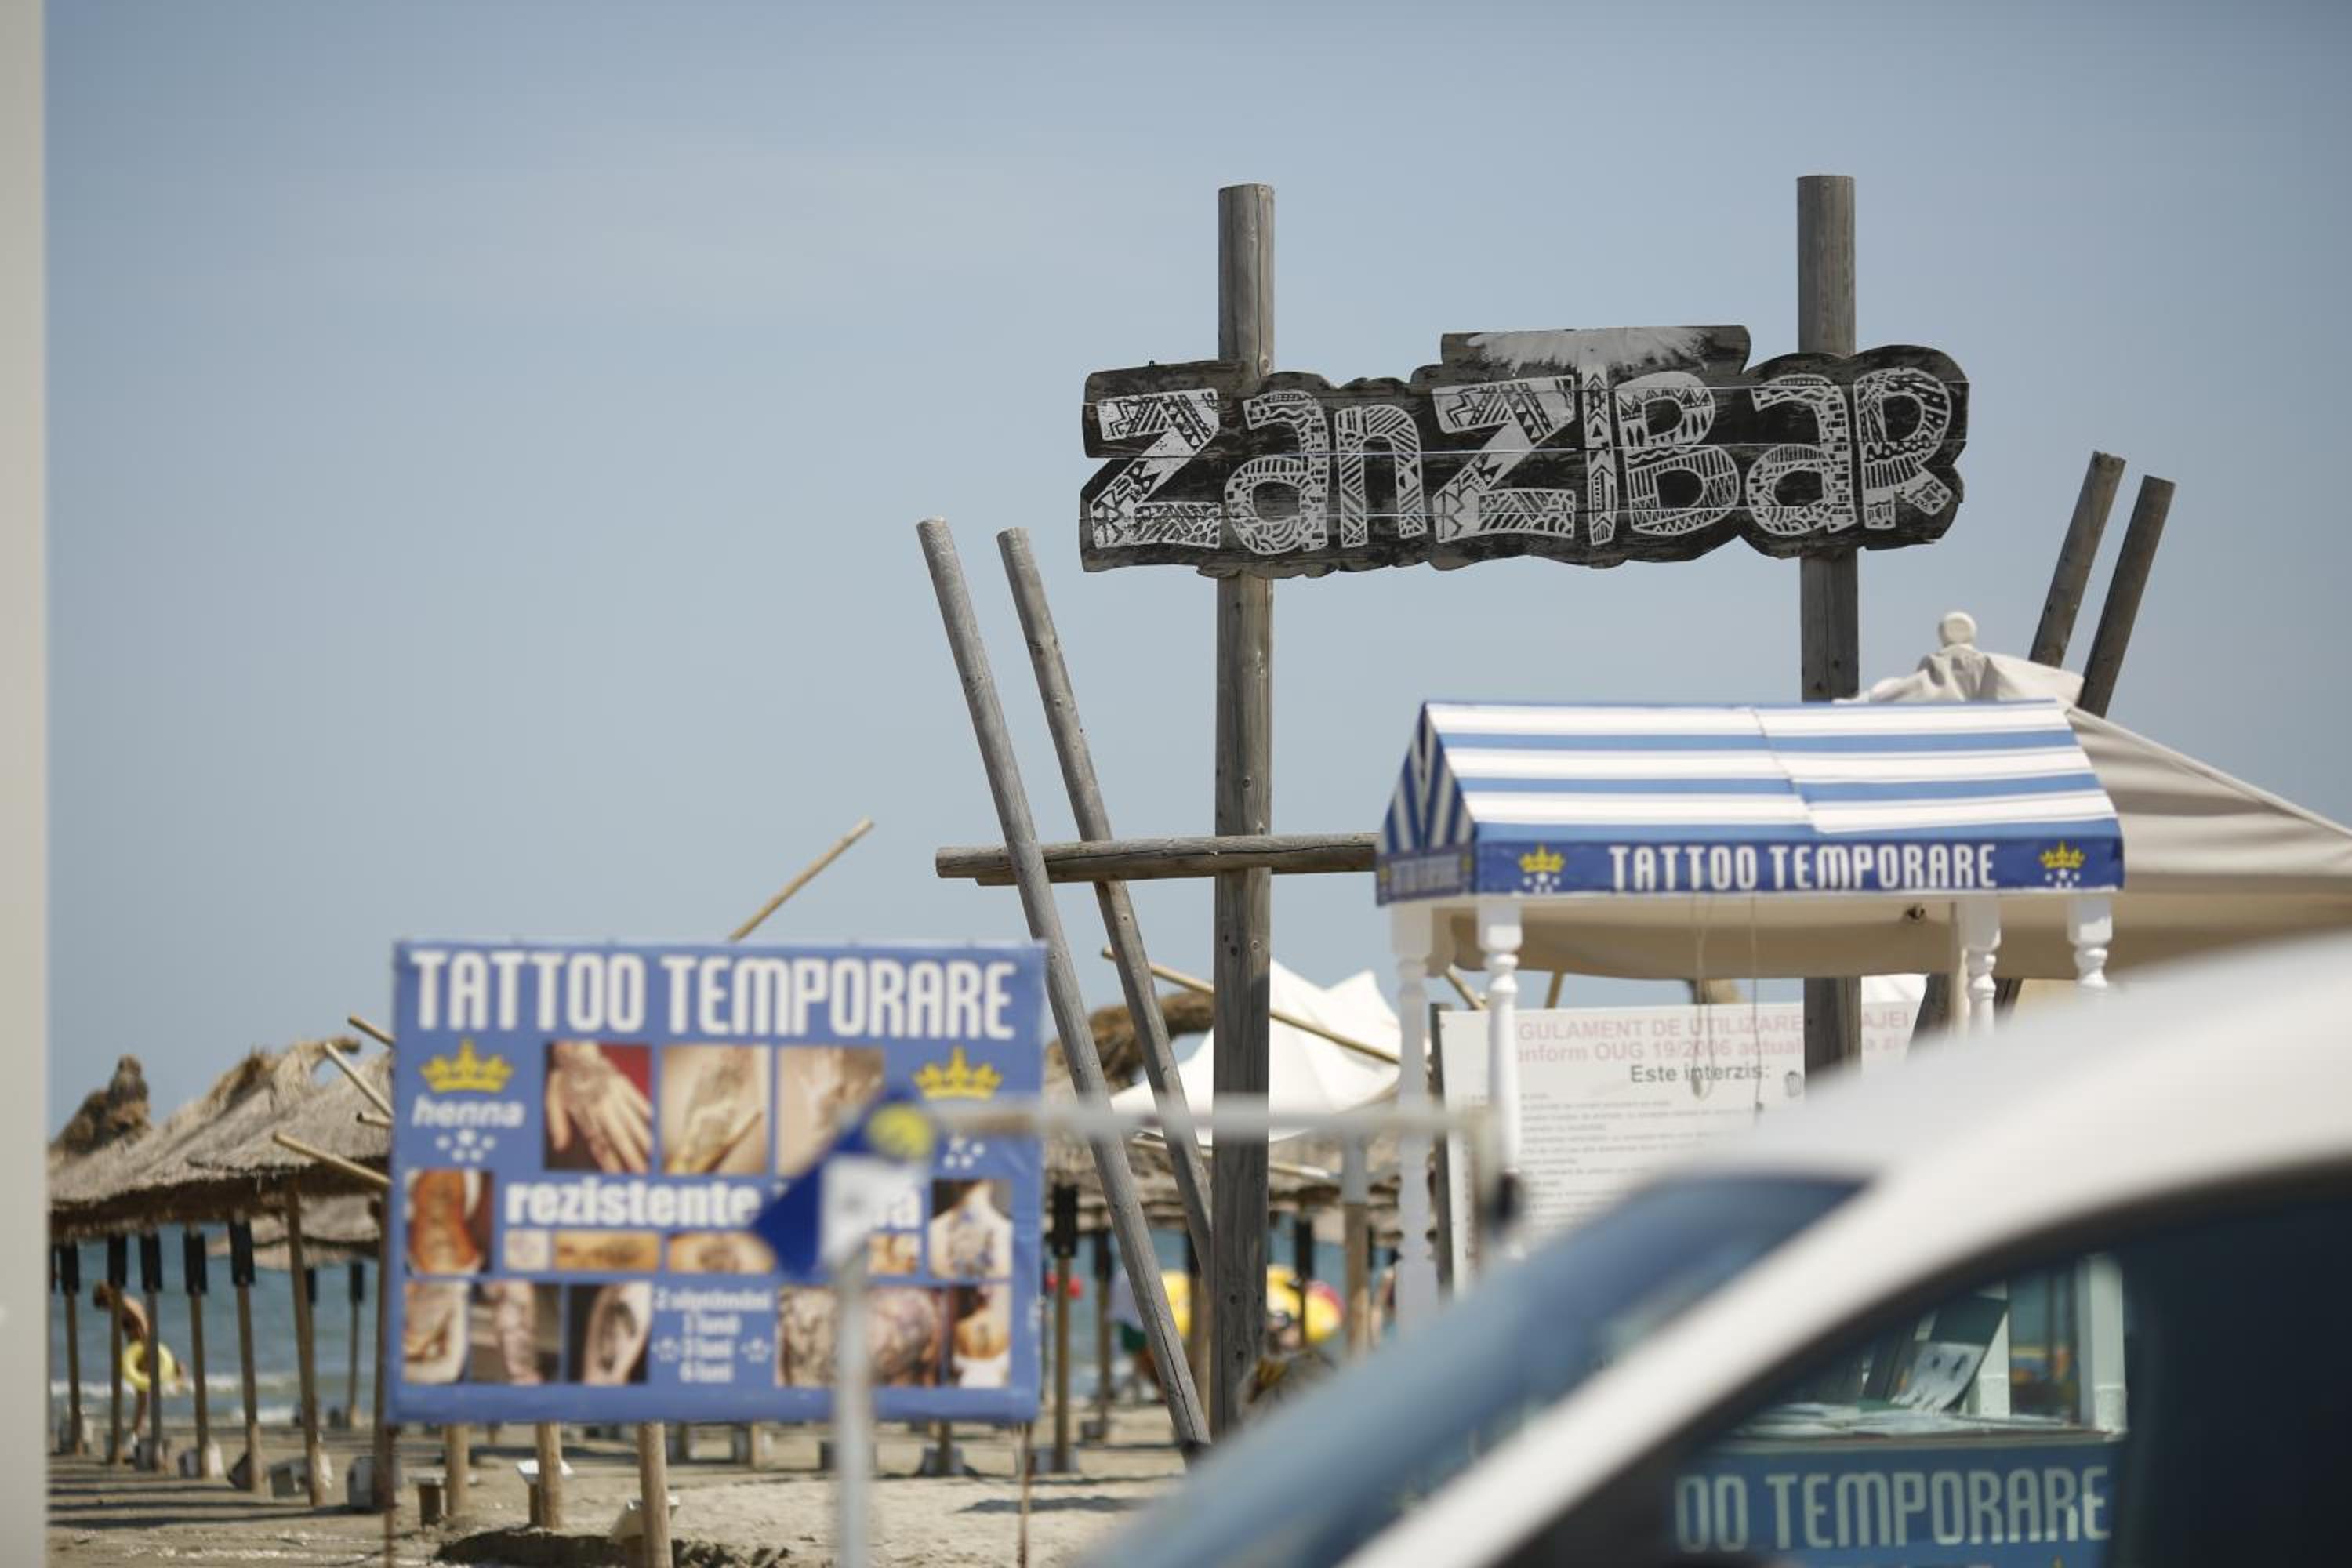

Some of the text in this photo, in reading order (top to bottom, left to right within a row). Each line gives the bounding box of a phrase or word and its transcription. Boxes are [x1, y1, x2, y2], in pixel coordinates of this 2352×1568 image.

[1609, 844, 1997, 890] TATTOO TEMPORARE
[411, 951, 1016, 1040] TATTOO TEMPORARE
[1518, 1021, 1644, 1040] GULAMENT
[1516, 1045, 1587, 1063] nform
[1630, 1065, 1677, 1083] Este
[412, 1094, 525, 1129] henna
[505, 1178, 763, 1226] rezistente
[1675, 1466, 2111, 1552] OO TEMPORARE
